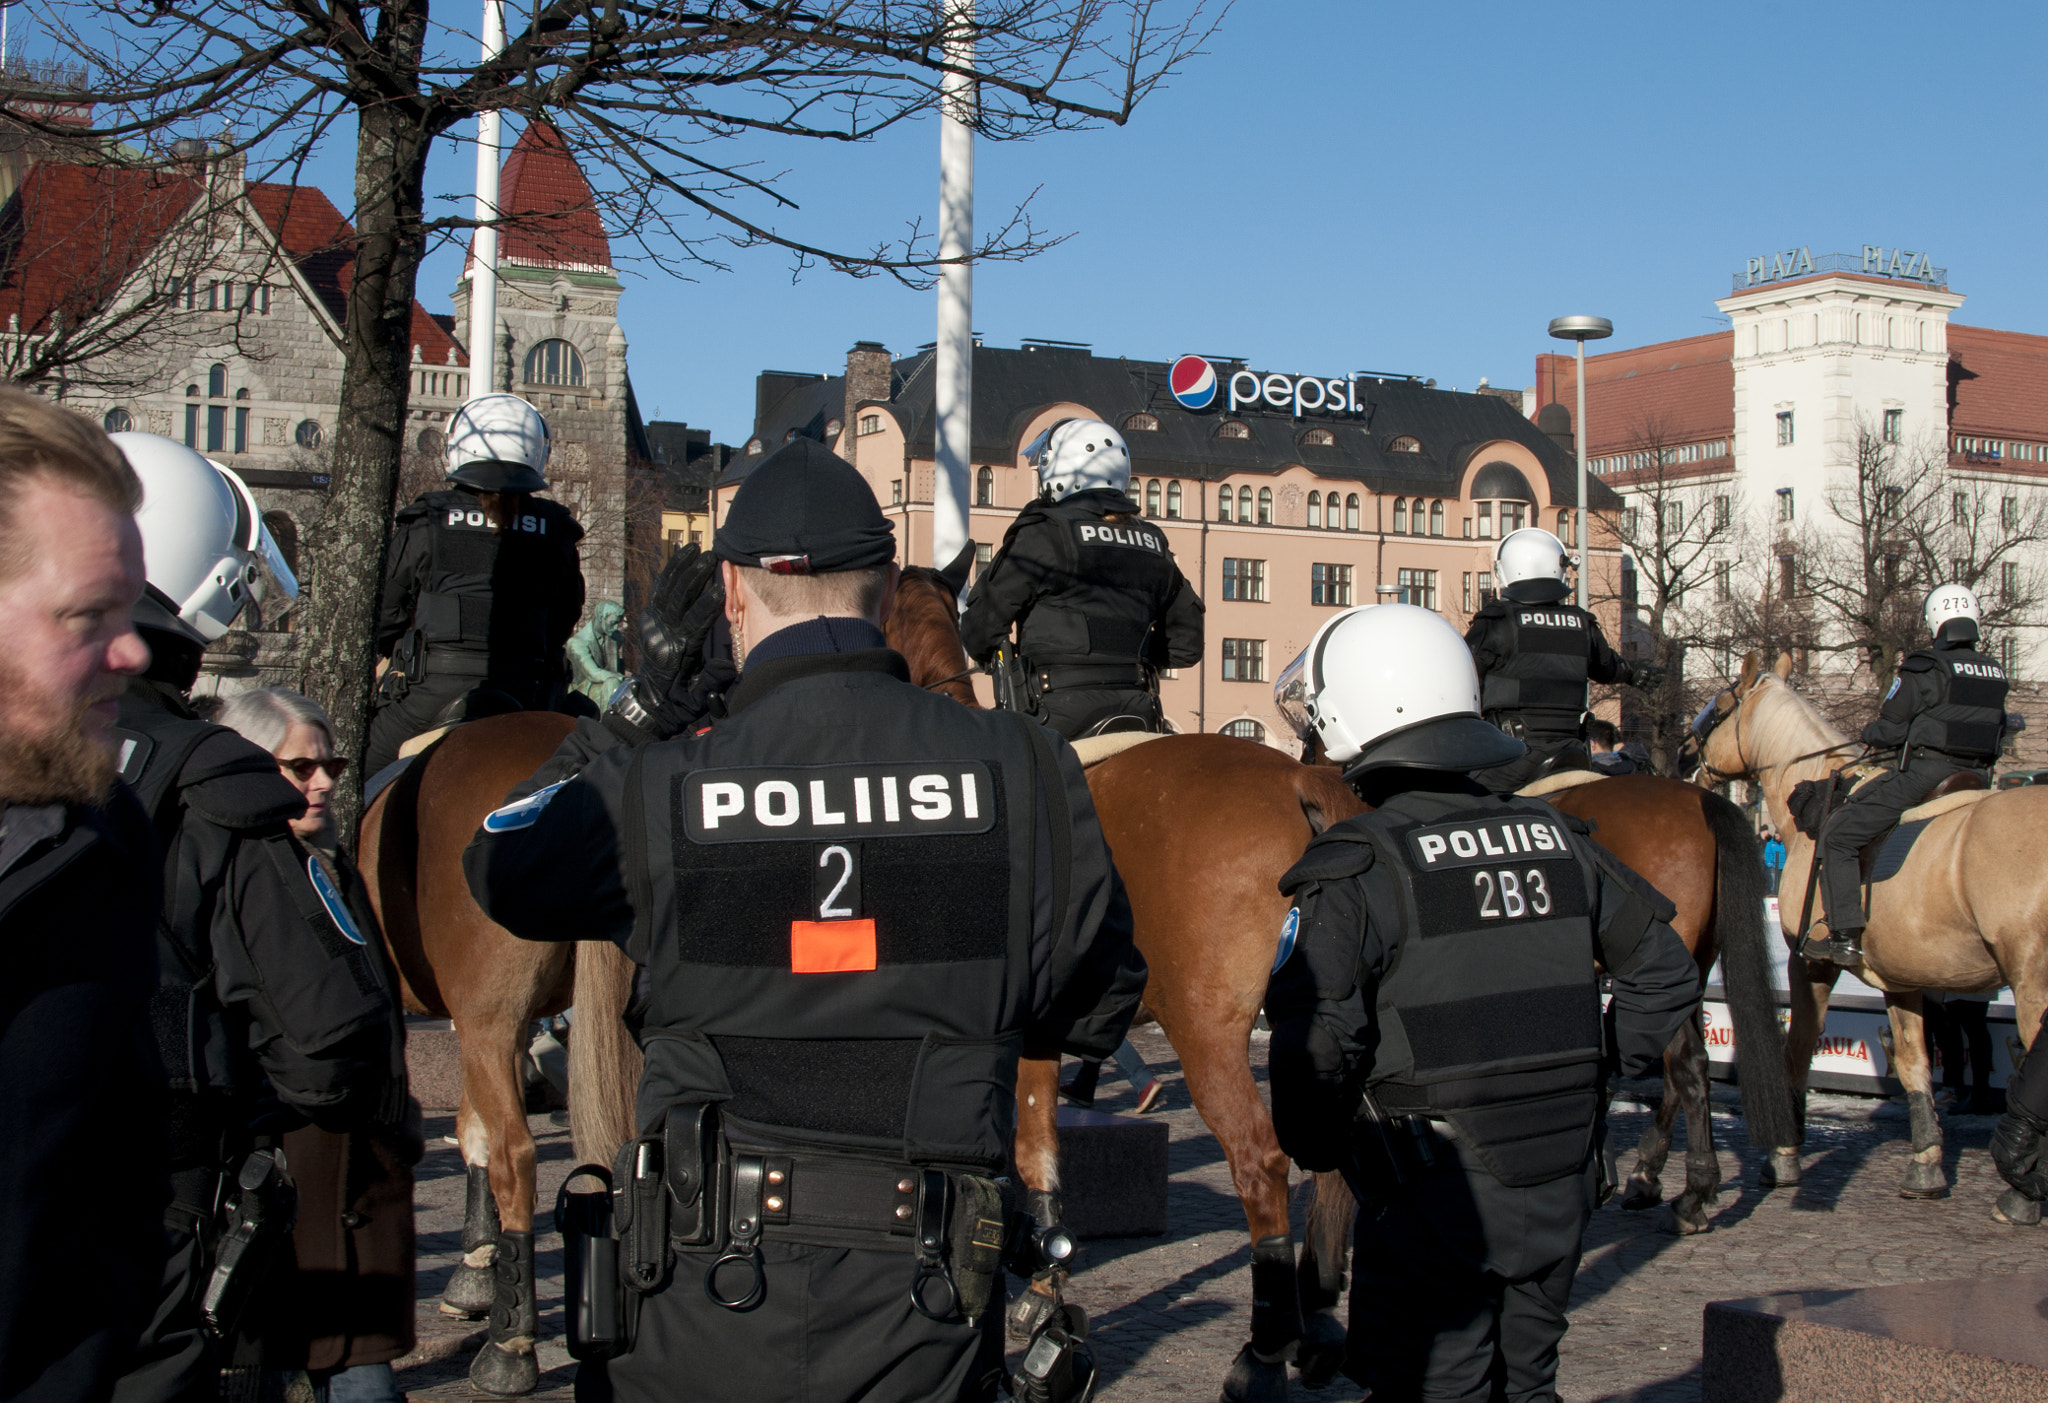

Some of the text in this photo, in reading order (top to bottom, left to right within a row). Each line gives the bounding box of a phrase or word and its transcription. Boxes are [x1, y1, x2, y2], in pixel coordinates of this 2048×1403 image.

[1747, 245, 1815, 286] PLAZA
[1863, 244, 1934, 282] PLAZA
[1228, 370, 1356, 418] pepsi
[448, 508, 546, 535] POLISI
[1080, 525, 1162, 553] POLIISI
[1520, 613, 1582, 629] POLIISI
[1943, 597, 1969, 611] 273
[1953, 662, 2006, 680] POLIISI
[701, 773, 979, 829] POLIISI
[1417, 823, 1568, 864] POLIISI
[819, 845, 853, 918] 2
[1474, 869, 1551, 918] 2B3
